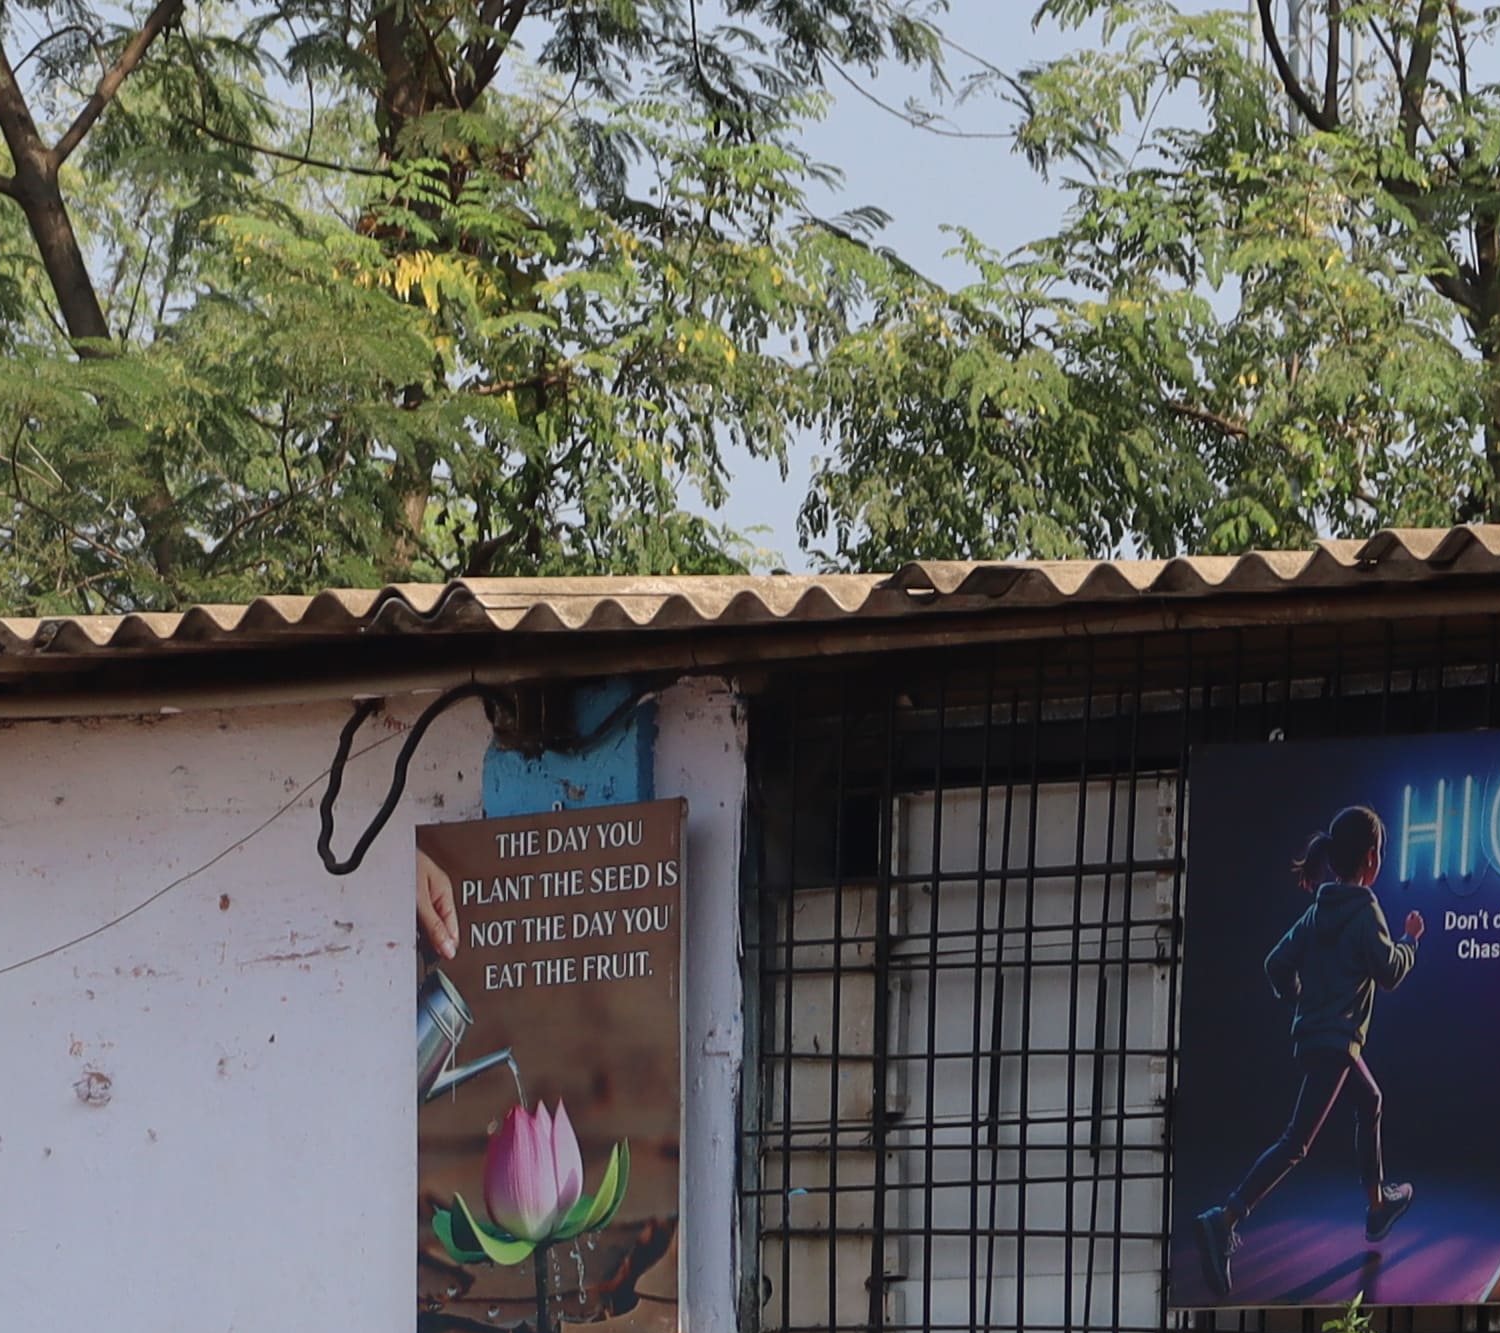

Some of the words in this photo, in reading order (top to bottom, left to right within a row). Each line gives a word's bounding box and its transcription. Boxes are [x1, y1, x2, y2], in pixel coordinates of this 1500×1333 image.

[496, 832, 540, 858] THE
[547, 825, 591, 854] DAY
[597, 820, 644, 848] YOU
[462, 875, 534, 906] PLANT
[541, 870, 583, 899] THE
[590, 864, 651, 895] SEED
[657, 860, 678, 888] IS
[470, 922, 516, 949] NOT
[523, 917, 566, 943] THE
[573, 911, 617, 938] DAY
[623, 904, 670, 932] YOU
[1444, 910, 1489, 931] Don't
[485, 962, 527, 991] EAT
[532, 957, 577, 985] THE
[582, 951, 653, 980] FRUIT.
